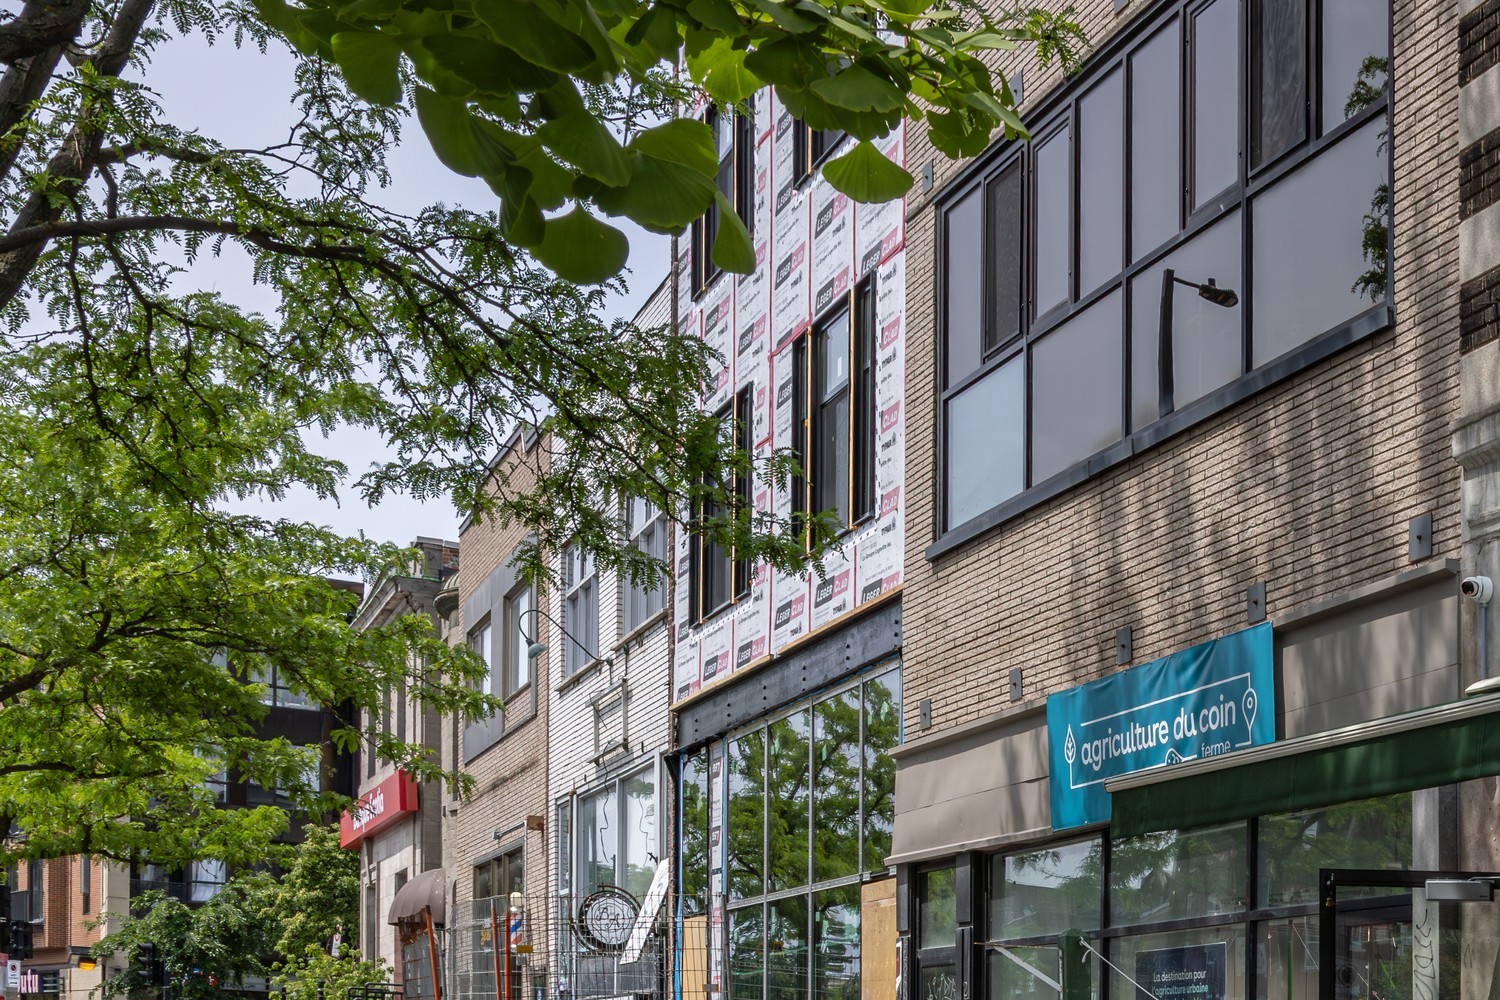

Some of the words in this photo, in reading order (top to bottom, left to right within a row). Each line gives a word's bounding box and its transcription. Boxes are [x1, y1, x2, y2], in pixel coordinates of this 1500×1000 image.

[817, 208, 833, 230] LEGER
[863, 250, 880, 275] LEGER
[816, 288, 832, 310] LEGER
[834, 275, 848, 294] CLAD
[883, 326, 898, 346] CLAD
[883, 411, 898, 429] CLAD
[883, 496, 898, 513] CLAD
[817, 584, 833, 603] LEGER
[834, 578, 849, 594] CLAD
[863, 588, 880, 603] LEGER
[776, 608, 791, 625] LEGER
[792, 602, 804, 617] CLAD
[738, 649, 751, 663] LEGER
[704, 662, 717, 677] LEGER
[1081, 720, 1169, 772] agriculture
[1173, 707, 1197, 740] du
[1199, 694, 1236, 733] coin
[1201, 740, 1231, 758] ferme
[18, 968, 39, 994] utu
[1153, 972, 1161, 982] La
[1161, 970, 1193, 982] destination
[1193, 969, 1207, 983] pour
[1186, 983, 1208, 994] urbaine
